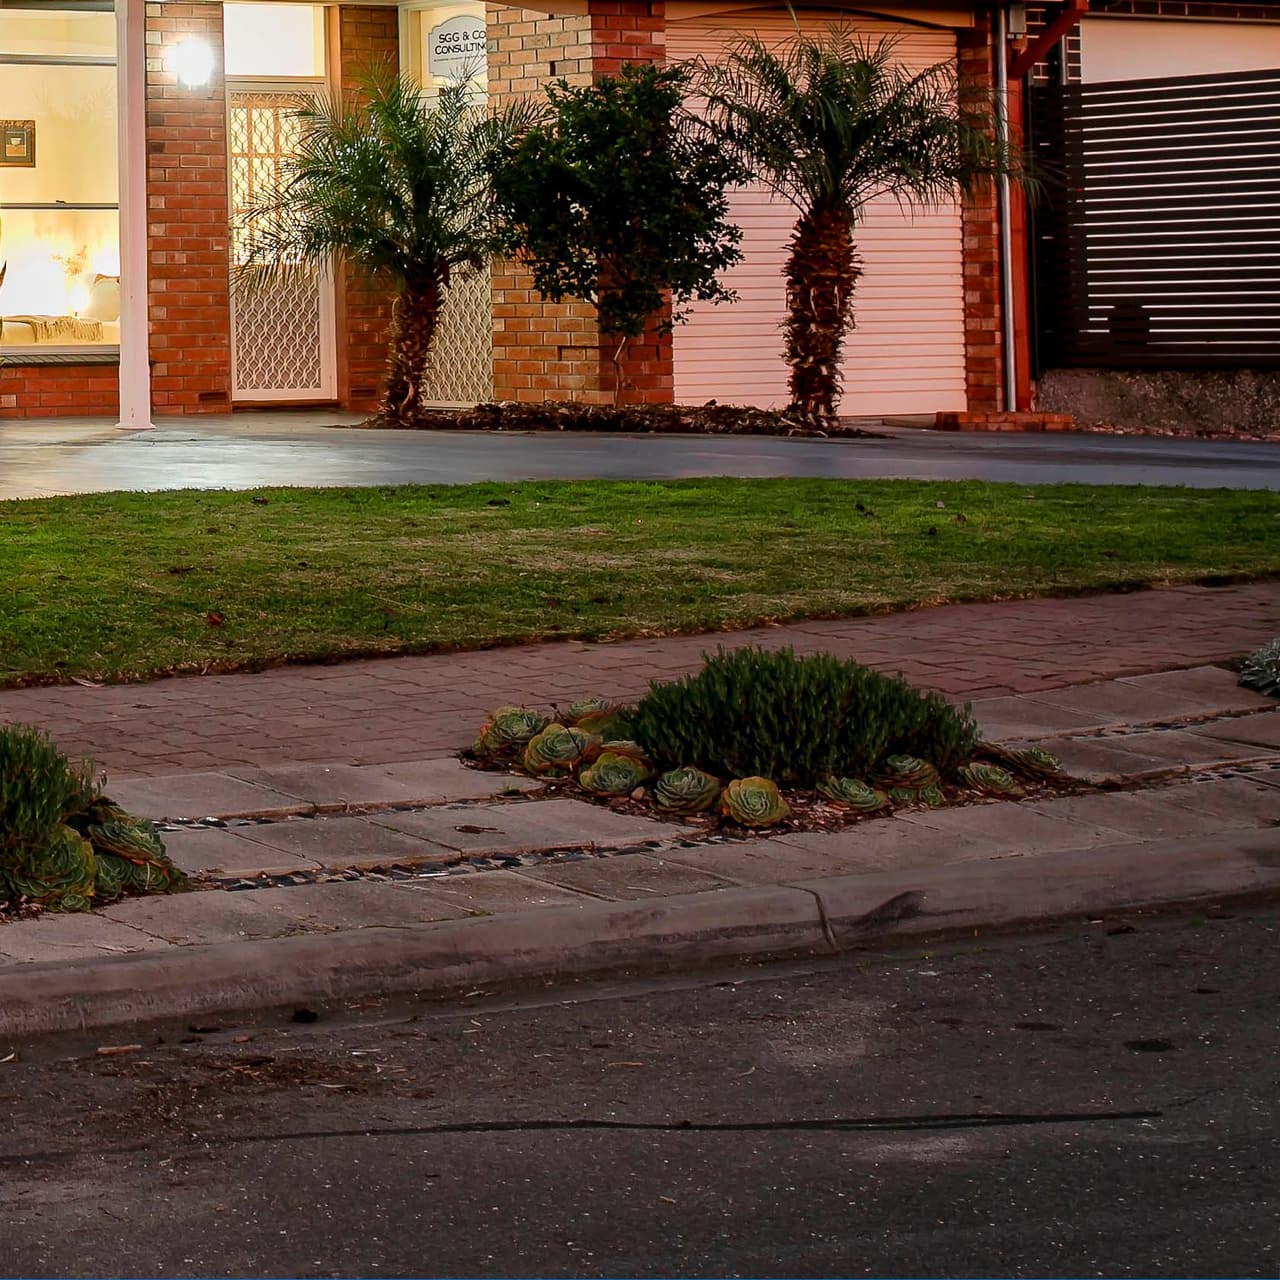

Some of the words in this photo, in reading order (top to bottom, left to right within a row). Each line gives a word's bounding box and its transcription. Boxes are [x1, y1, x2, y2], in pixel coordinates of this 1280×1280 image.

[438, 32, 460, 43] SGG
[462, 31, 469, 41] &
[434, 42, 487, 55] CONSULTIN
